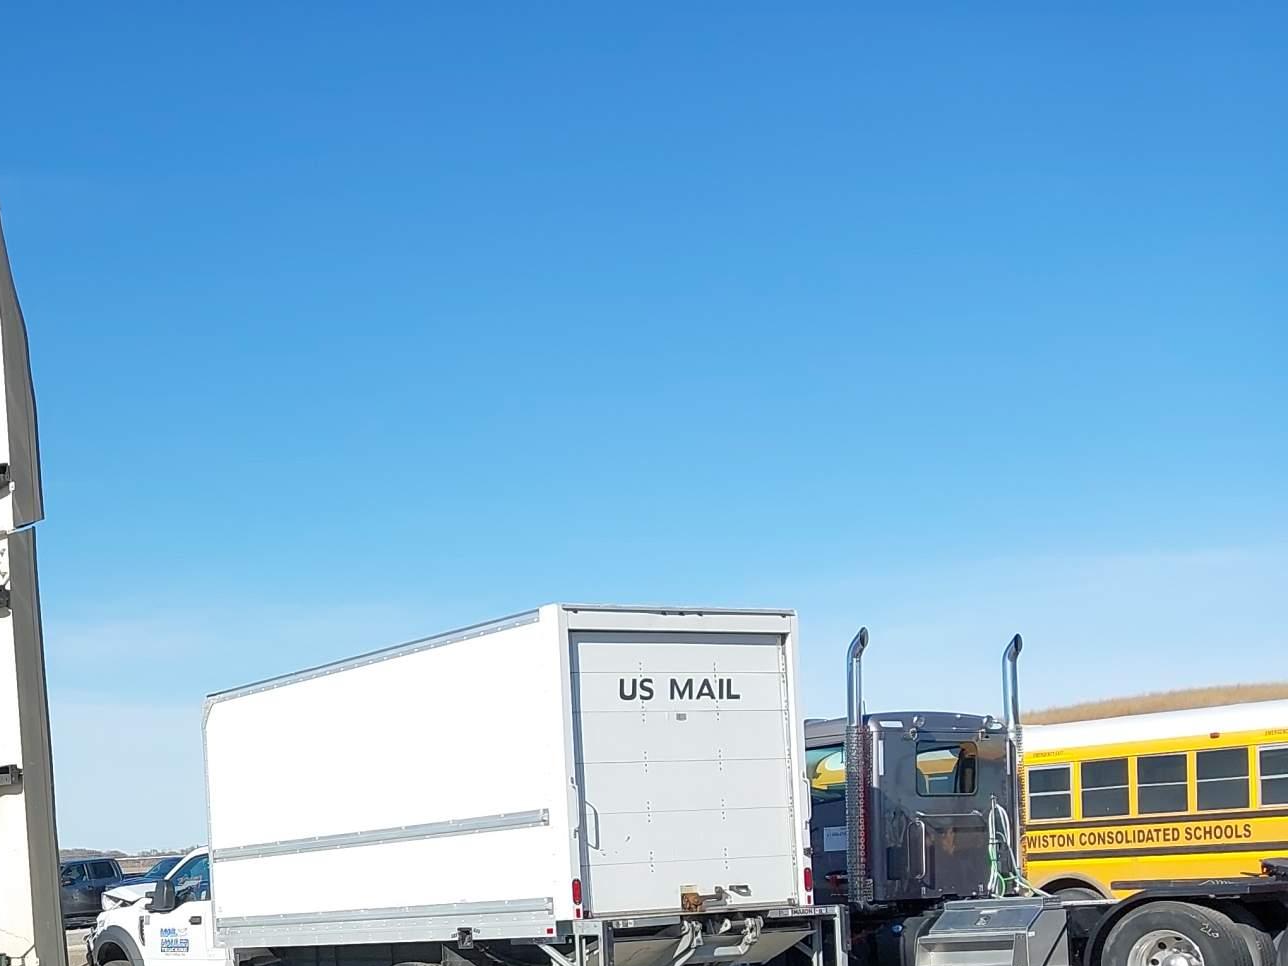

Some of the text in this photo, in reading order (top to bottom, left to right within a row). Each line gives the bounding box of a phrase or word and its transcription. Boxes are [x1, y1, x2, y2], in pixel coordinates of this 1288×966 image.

[619, 678, 740, 701] US MAIL
[1079, 827, 1180, 846] CONSOLIDATED
[1185, 824, 1252, 841] SCHOOLS
